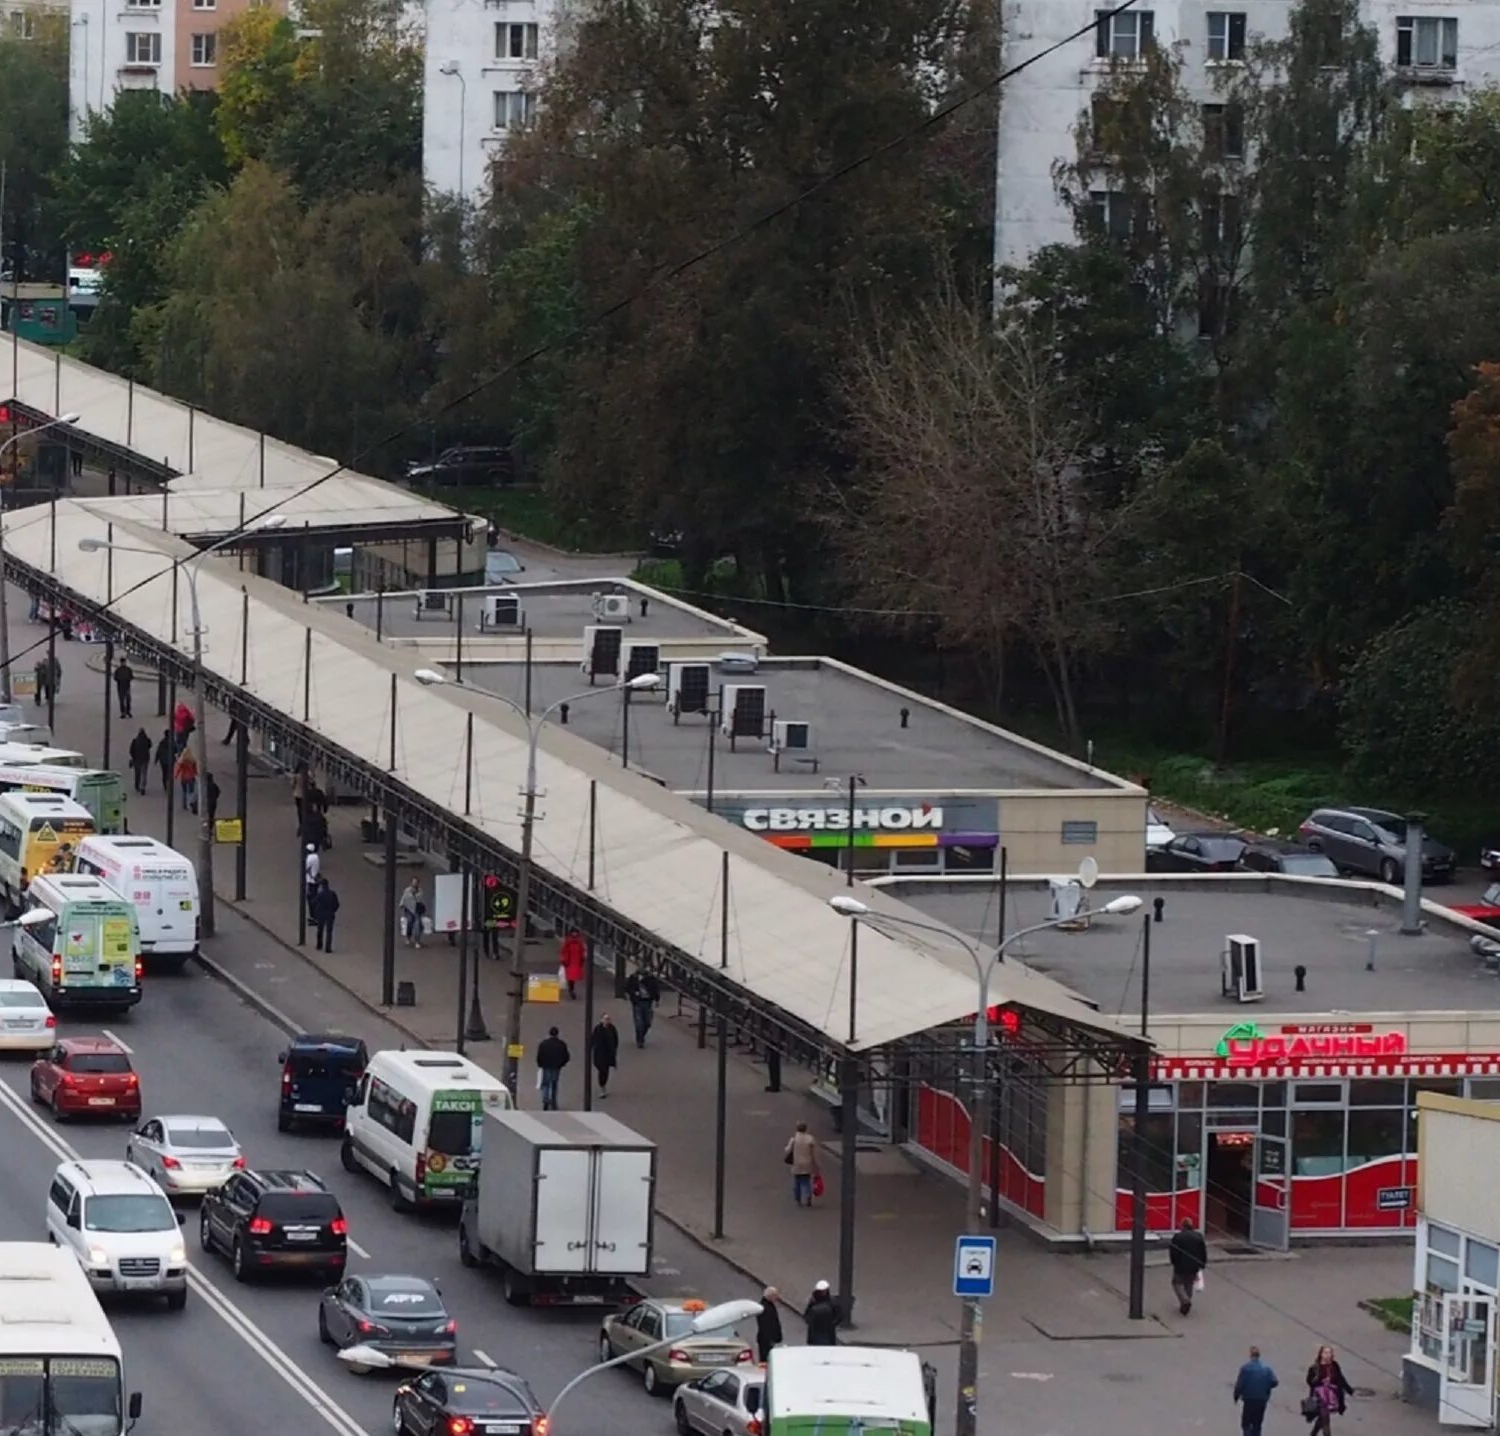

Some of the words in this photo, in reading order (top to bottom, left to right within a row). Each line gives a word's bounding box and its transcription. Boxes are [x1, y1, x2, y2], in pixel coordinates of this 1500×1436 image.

[743, 803, 943, 830] СВЯЗНОЙ
[1298, 1025, 1357, 1033] МАГАЗИН
[1227, 1032, 1407, 1066] УДАЧНЫЙ
[435, 1101, 476, 1112] ТАКСИ
